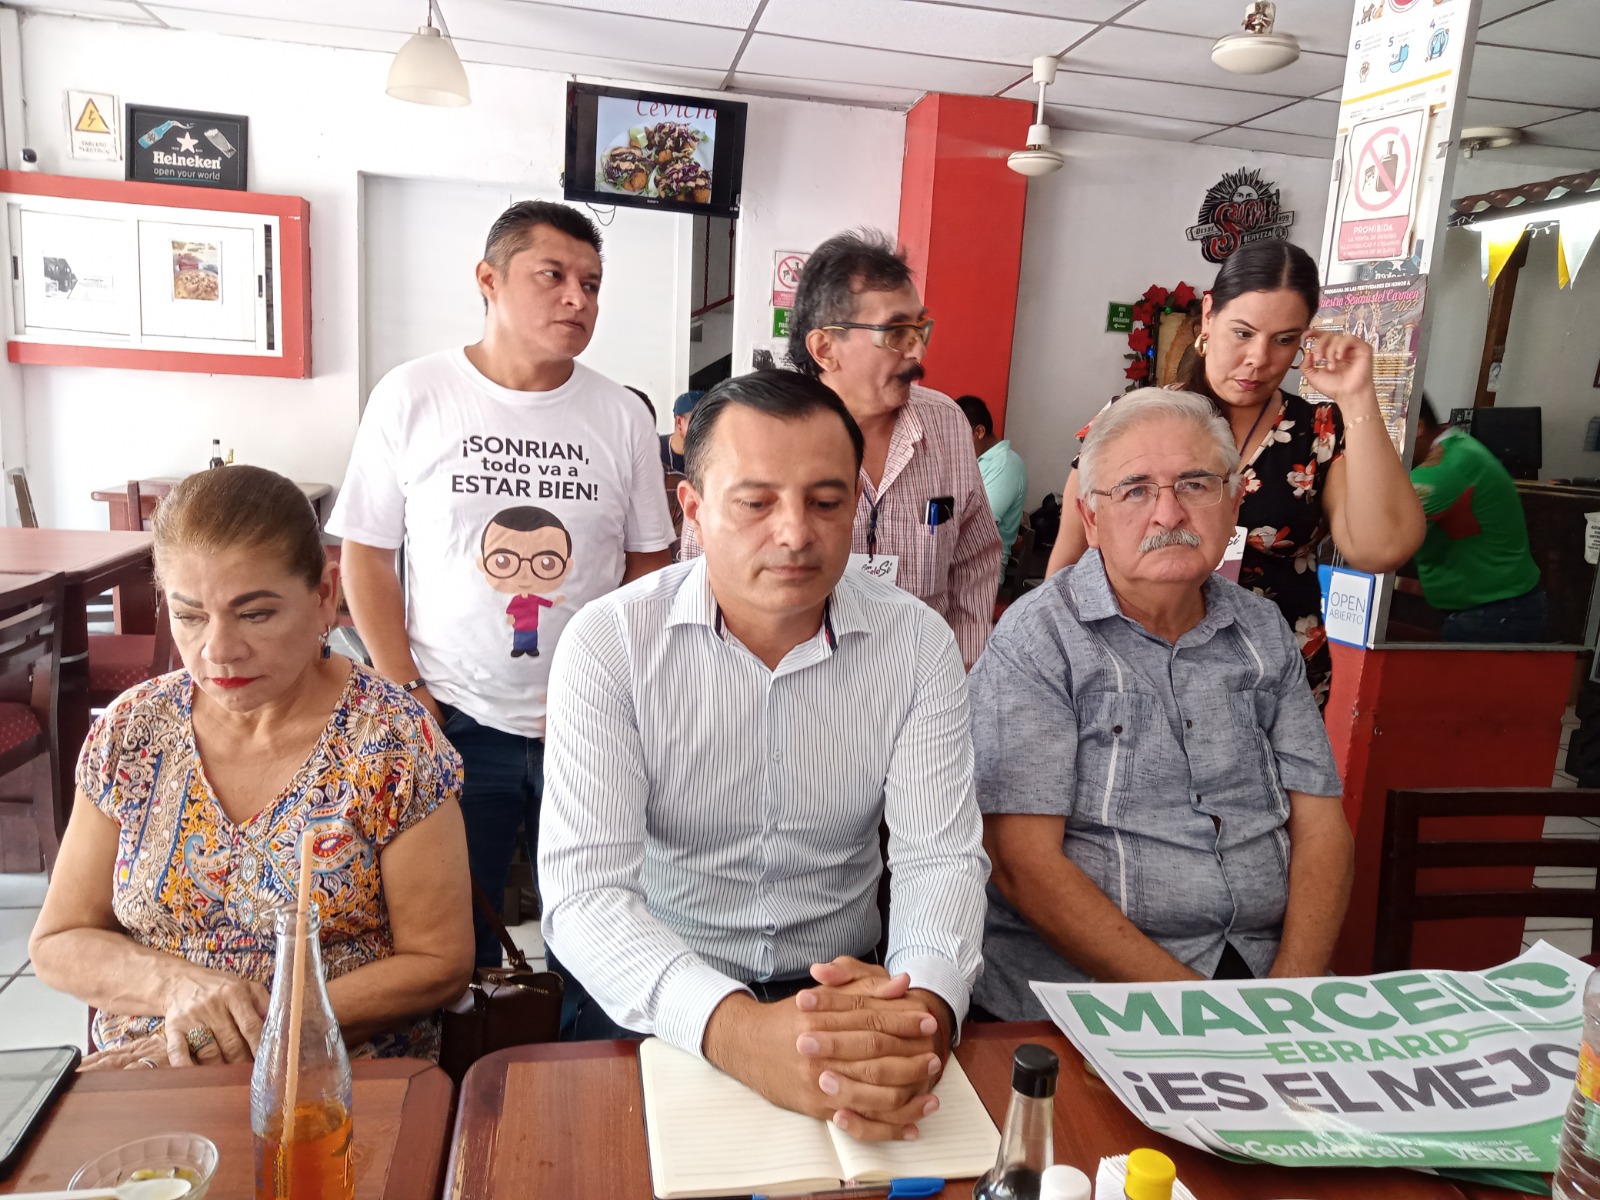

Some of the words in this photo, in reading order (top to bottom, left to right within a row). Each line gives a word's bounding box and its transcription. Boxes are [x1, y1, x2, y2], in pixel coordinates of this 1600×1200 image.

[1355, 40, 1362, 50] 6
[1388, 36, 1395, 47] 5
[152, 150, 222, 170] Heineken
[153, 168, 175, 178] open
[177, 169, 196, 179] your
[197, 170, 221, 181] world
[1353, 224, 1394, 234] PROHIBIDA
[1386, 288, 1419, 301] Carmen
[1392, 300, 1418, 312] 2023
[462, 435, 590, 465] ¡SONRIAN,
[481, 456, 531, 474] todo
[537, 463, 562, 477] va
[567, 464, 579, 477] a
[451, 475, 531, 498] ESTAR
[538, 480, 599, 501] BIEN!
[1330, 591, 1366, 613] OPEN
[1328, 608, 1364, 625] ABIERTO
[1066, 962, 1577, 1037] MARCELO
[1264, 1027, 1470, 1065] EBRARD
[1122, 1070, 1269, 1115] ¡ES
[1262, 1070, 1385, 1113] EL
[1366, 1042, 1580, 1112] MEJO
[1446, 1145, 1541, 1163] VERDE
